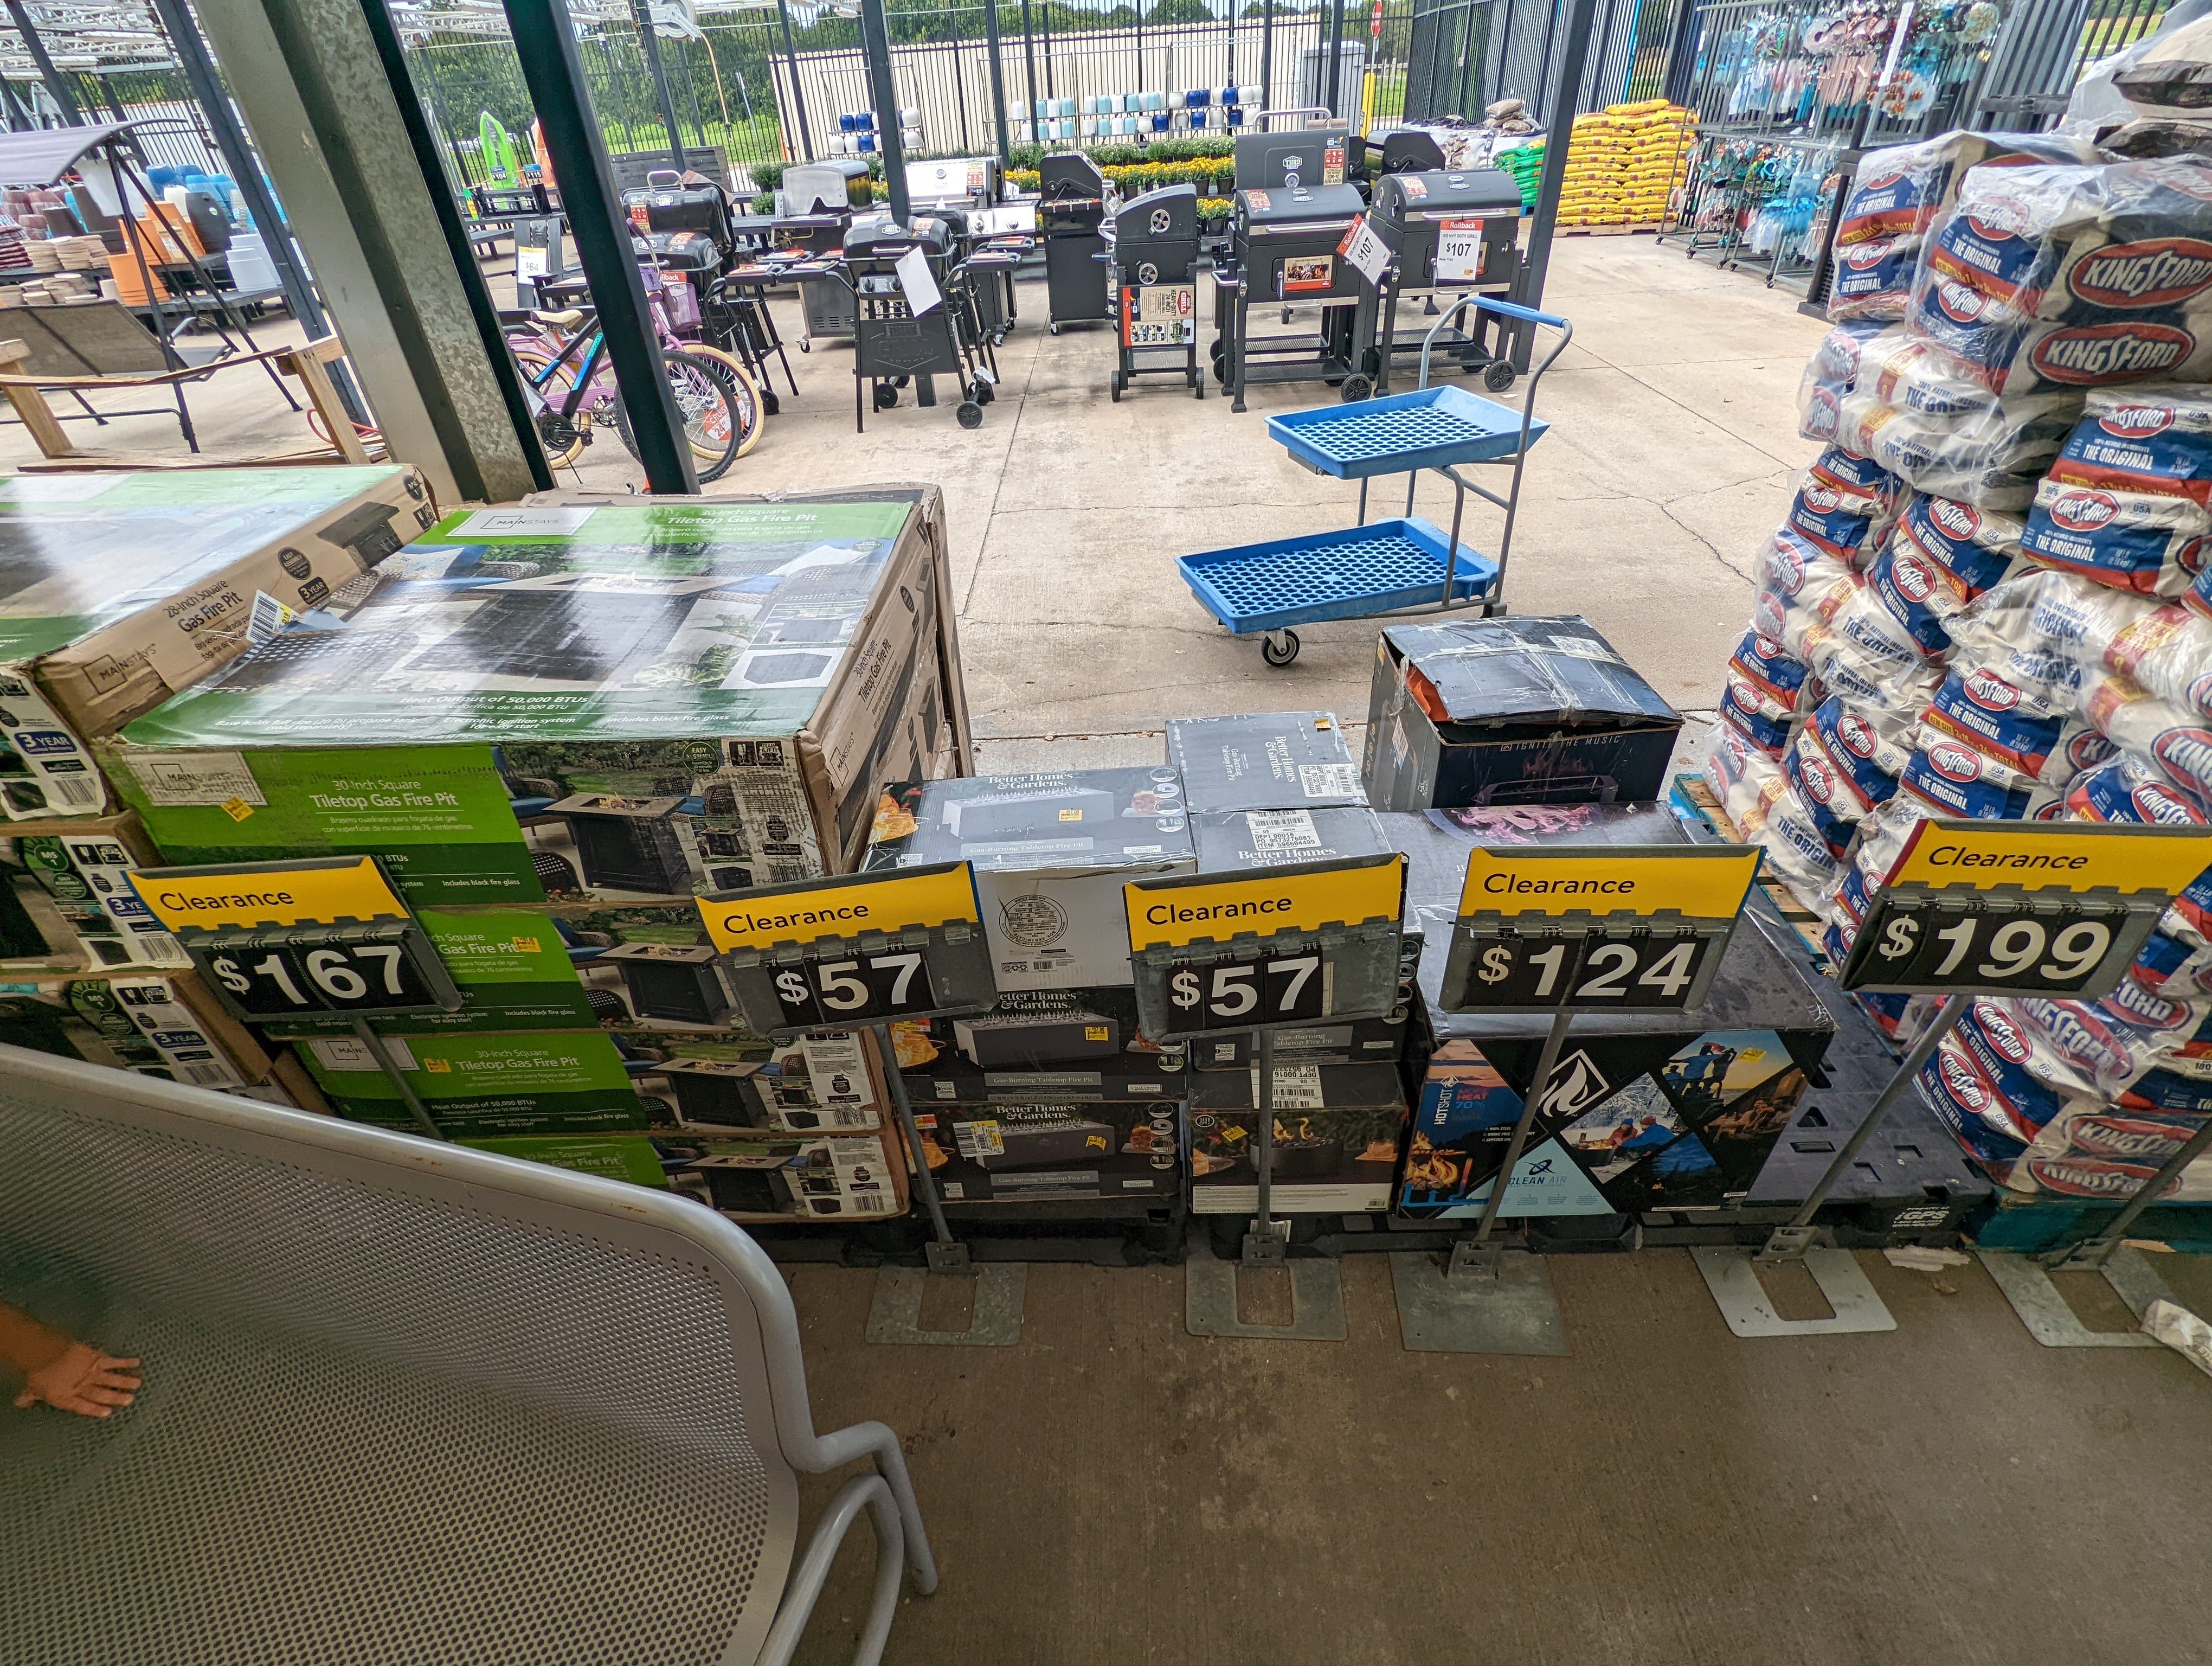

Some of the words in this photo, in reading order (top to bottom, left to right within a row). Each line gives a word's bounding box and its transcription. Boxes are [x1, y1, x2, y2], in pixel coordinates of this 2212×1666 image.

[1865, 195, 1896, 212] ORIGINAL
[1345, 223, 1359, 246] Rollback
[1357, 236, 1374, 260] $107
[1446, 243, 1471, 257] $107
[1963, 245, 2002, 274] ORIGINAL
[526, 262, 538, 271] $64
[2082, 250, 2212, 297] KINGSFORD
[1851, 278, 1882, 292] ORIGINAL
[2044, 334, 2181, 376] KINGSFORD
[2082, 444, 2099, 459] THE
[2099, 448, 2154, 470] ORIGINAL
[1834, 463, 1861, 485] ORIGINAL
[667, 516, 723, 525] Tiletop
[1932, 498, 1975, 535] KINGSFORD
[2055, 498, 2113, 523] KINGSFORD
[1802, 517, 1827, 537] ORIGINAL
[1922, 534, 1955, 568] ORIGINAL
[2035, 534, 2051, 552] THE
[2050, 541, 2095, 562] ORIGINAL
[164, 594, 196, 619] 28-Inch
[195, 579, 229, 600] Square
[300, 587, 311, 600] 3
[308, 581, 325, 595] YEAR
[178, 615, 205, 633] Gas
[202, 601, 226, 621] Fire
[222, 591, 243, 611] Pit
[1886, 593, 1909, 626] ORIGINAL
[884, 638, 892, 651] Pit
[876, 650, 888, 666] Fire
[1748, 658, 1770, 680] ORIGINAL
[873, 662, 881, 678] Gas
[436, 696, 485, 704] Output
[858, 677, 874, 703] Tiletop
[1733, 685, 1760, 710] KINGSFORD
[1966, 676, 2015, 705] KINGSFORD
[1726, 704, 1734, 718] THE
[1733, 712, 1753, 734] ORIGINAL
[1947, 703, 1962, 720] THE
[1962, 713, 2002, 740] ORIGINAL
[19, 734, 36, 747] 3
[37, 736, 72, 746] YEAR
[1275, 736, 1289, 758] Better
[1516, 741, 1553, 750] IGNITE
[1560, 739, 1578, 747] THE
[1585, 735, 1620, 745] MUSIC
[1842, 717, 1872, 754] KINGSFORD
[1822, 730, 1832, 748] THE
[1830, 745, 1857, 778] ORIGINAL
[1881, 753, 1894, 765] USA
[1931, 747, 1976, 777] KINGSFORD
[988, 776, 1027, 784] Better
[1281, 758, 1297, 783] Homes
[1319, 774, 1327, 786] 00016
[1801, 760, 1829, 800] KINGSFORD
[1990, 765, 2005, 776] USA
[378, 779, 422, 792] Square
[1918, 774, 1930, 790] THE
[1930, 781, 1967, 810] ORIGINAL
[309, 794, 368, 810] Tiletop
[369, 793, 402, 807] Gas
[403, 793, 433, 806] Fire
[434, 792, 459, 806] Pit
[1798, 790, 1816, 822] ORIGINAL
[1777, 815, 1795, 840] THE
[970, 845, 1018, 853] Gas-Burning
[1238, 850, 1283, 859] Better
[1285, 848, 1336, 858] Homes
[1928, 845, 2089, 870] Clearance
[1483, 873, 1636, 894] Clearance
[113, 899, 125, 911] 3
[159, 889, 295, 912] Clearance
[1146, 898, 1293, 925] Clearance
[1850, 894, 1861, 911] THE
[723, 902, 870, 934] Clearance
[438, 944, 466, 954] Gas
[467, 944, 496, 953] Fire
[498, 943, 519, 953] Pit
[447, 934, 486, 942] Square
[1879, 914, 2111, 981] $199
[213, 945, 403, 1005] $167
[775, 953, 922, 1010] $57
[1477, 943, 1697, 997] $124
[1032, 991, 1077, 1001] Homes
[1171, 956, 1320, 1017] $57
[160, 1033, 172, 1043] 3
[172, 1034, 200, 1042] YEAR
[1278, 1033, 1326, 1042] Gas-Burning
[1978, 1005, 2025, 1059] KINGSFORD
[475, 1050, 512, 1058] 30-Inch
[514, 1049, 549, 1058] Square
[1957, 1017, 1971, 1040] THE
[1969, 1036, 2005, 1085] ORIGINAL
[455, 1061, 504, 1071] Tiletop
[506, 1059, 532, 1068] Gas
[535, 1058, 558, 1067] Fire
[561, 1056, 580, 1066] Pit
[2038, 1063, 2054, 1080] USA
[1942, 1054, 1984, 1108] KINGSFORD
[996, 1105, 1030, 1114] Better
[1031, 1104, 1076, 1113] Homes
[1433, 1088, 1453, 1125] HOTSHOT
[1925, 1068, 1935, 1088] THE
[1933, 1085, 1964, 1133] ORIGINAL
[1995, 1113, 2009, 1129] USA
[1508, 1176, 1545, 1185] CLEAN
